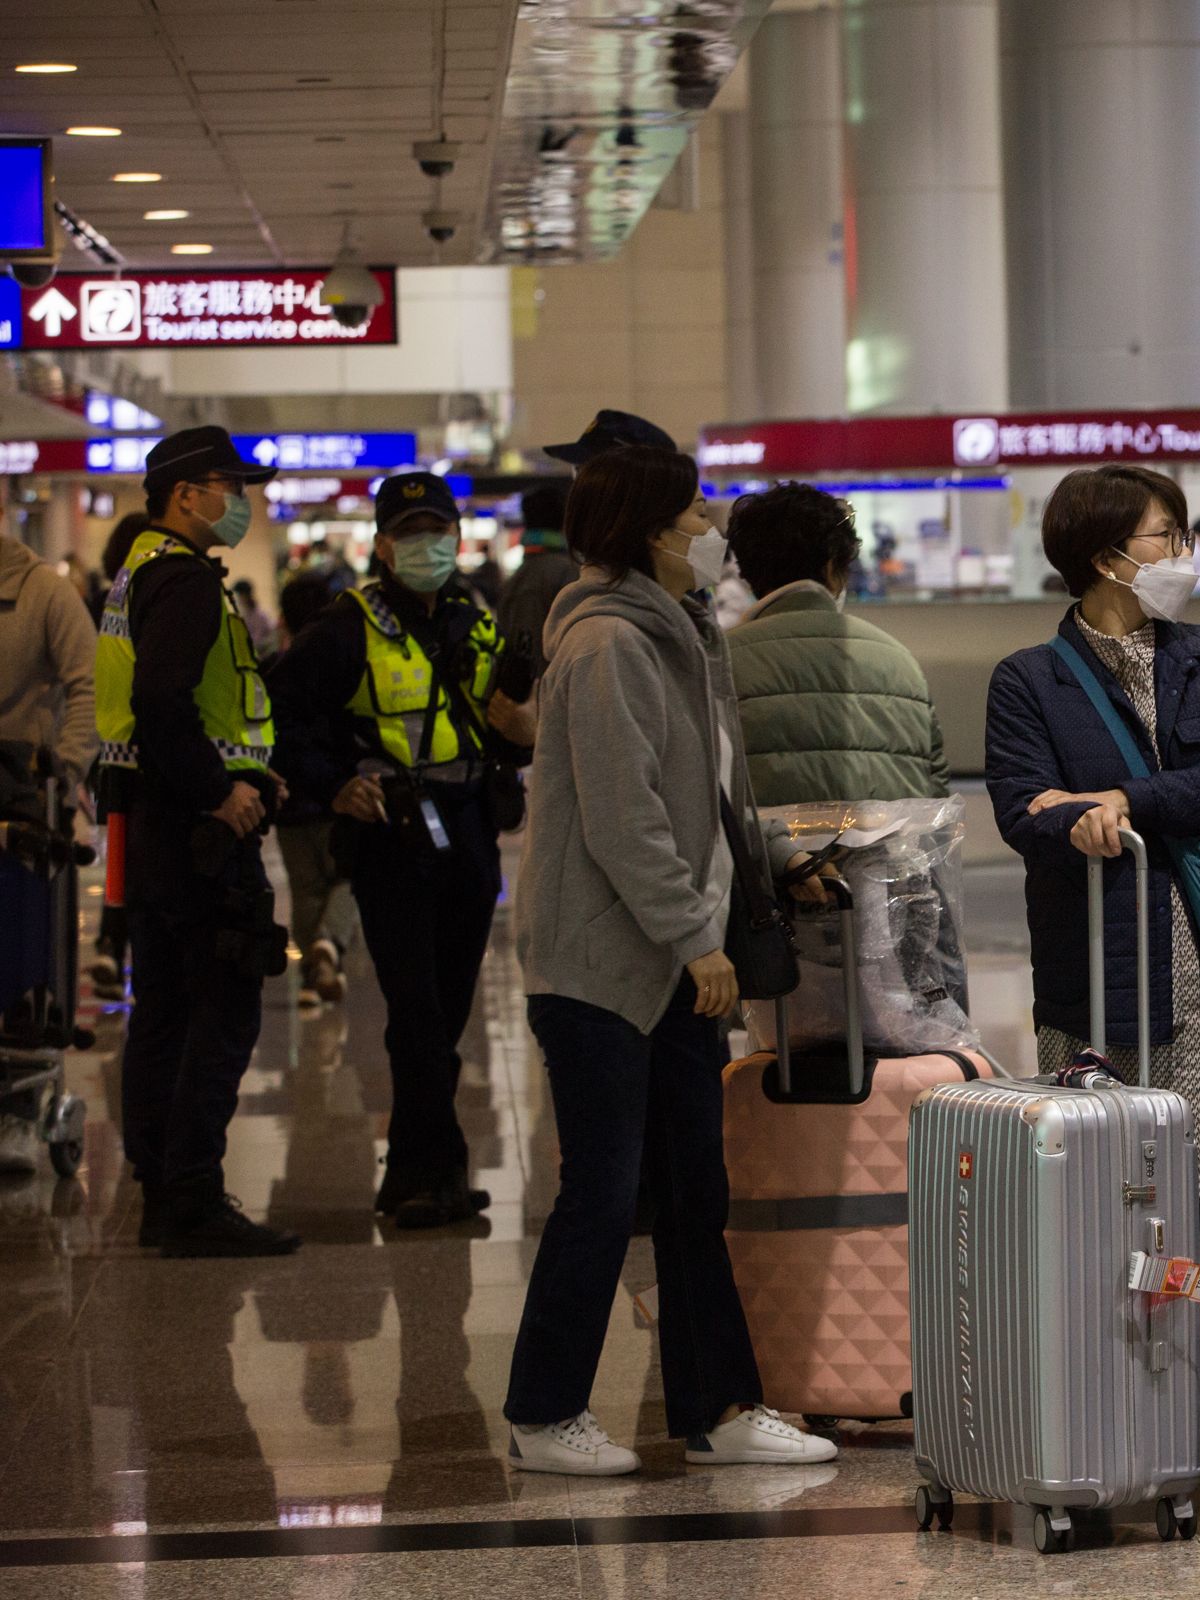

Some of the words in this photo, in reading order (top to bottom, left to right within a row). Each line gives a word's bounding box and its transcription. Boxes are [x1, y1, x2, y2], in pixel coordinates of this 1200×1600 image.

[143, 316, 219, 341] Tourist
[219, 316, 298, 340] service
[999, 421, 1157, 456] 旅客服務中心
